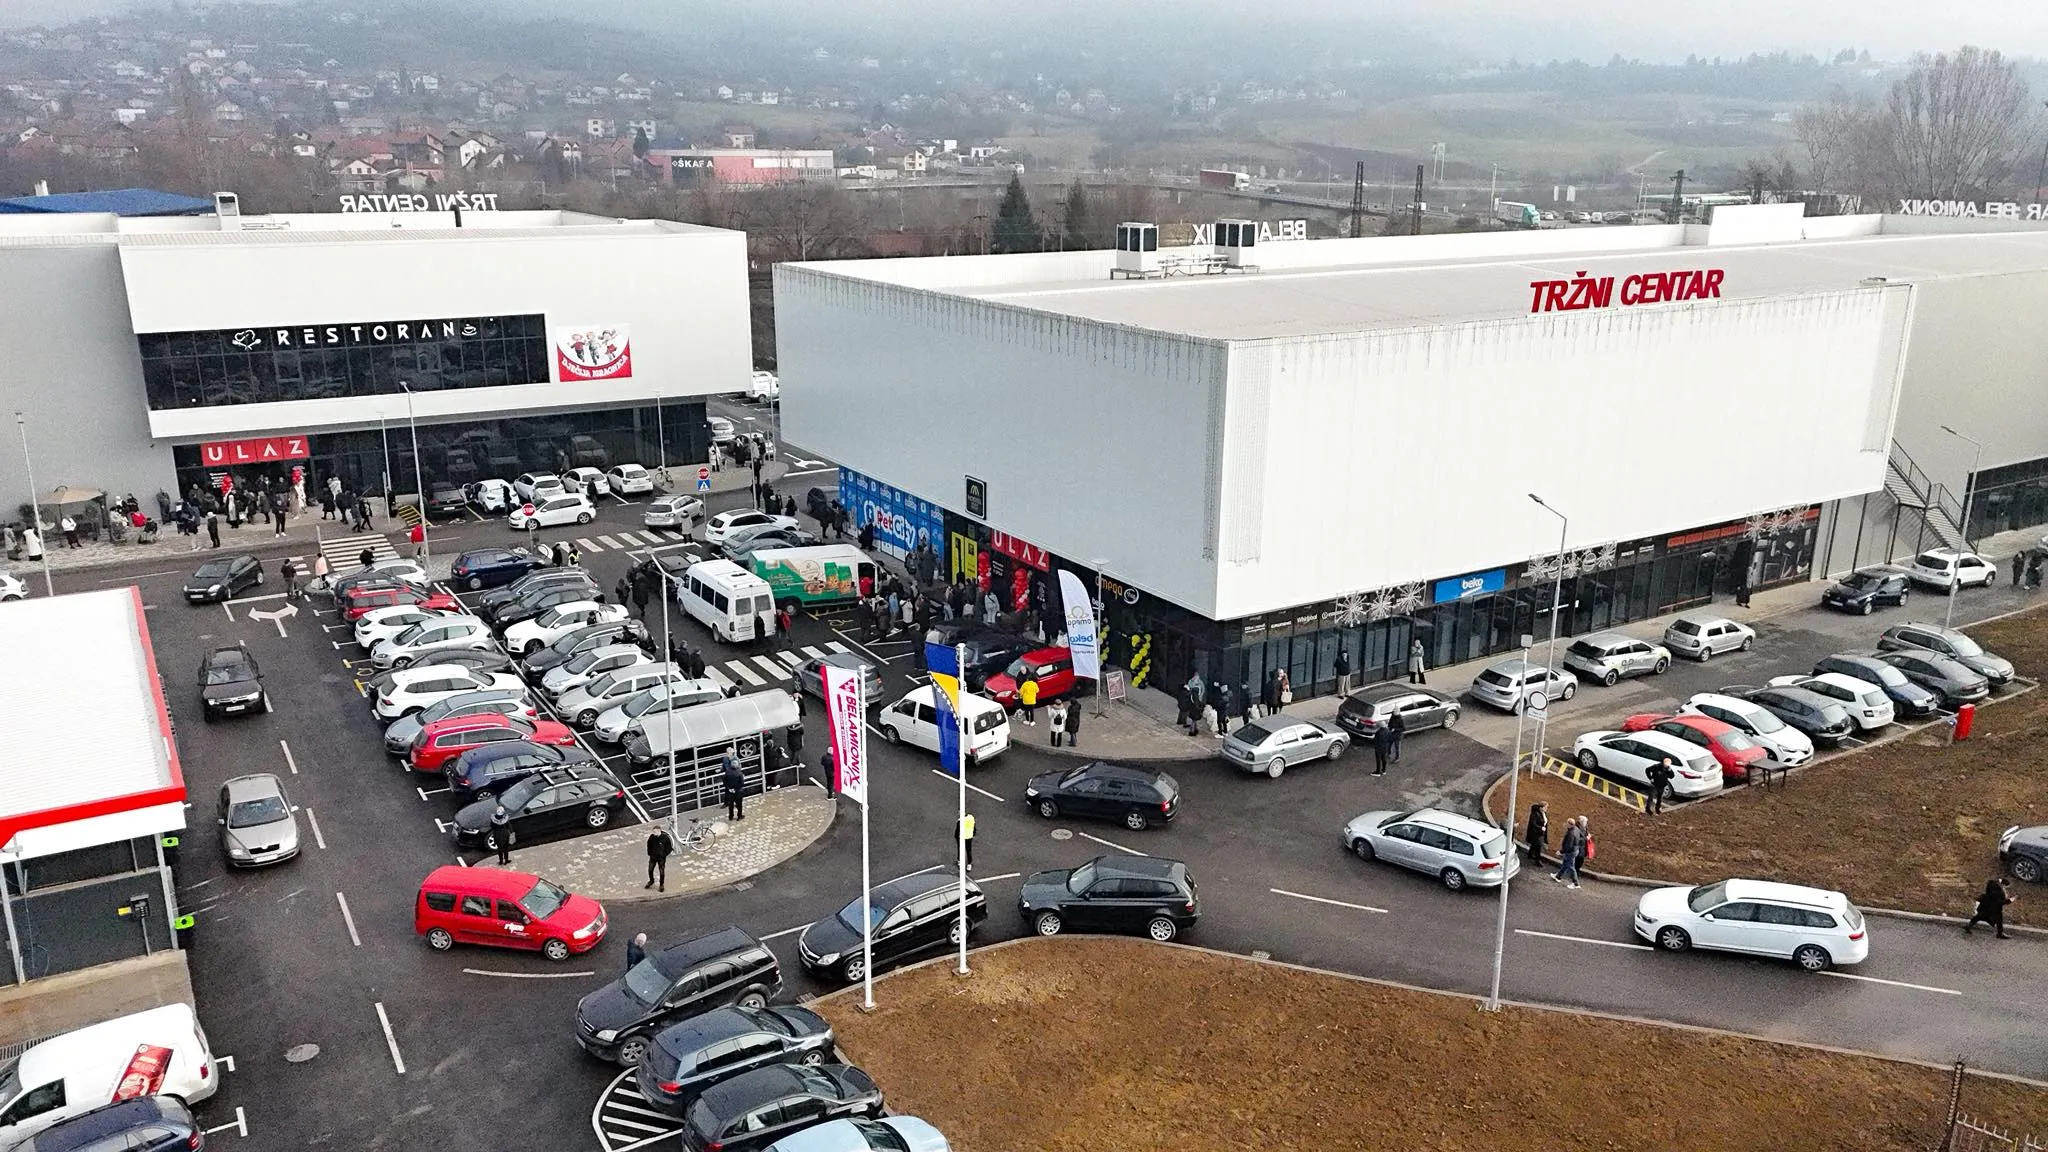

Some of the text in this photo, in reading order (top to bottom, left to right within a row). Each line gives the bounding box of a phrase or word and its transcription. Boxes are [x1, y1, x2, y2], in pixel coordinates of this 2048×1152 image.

[1530, 269, 1724, 313] TRŽNI CENTAR
[276, 321, 455, 346] RESTORAN
[207, 439, 304, 462] ULAZ
[993, 530, 1047, 568] ULAZ
[1462, 577, 1484, 590] beko
[846, 695, 861, 785] BELAMIONIX
